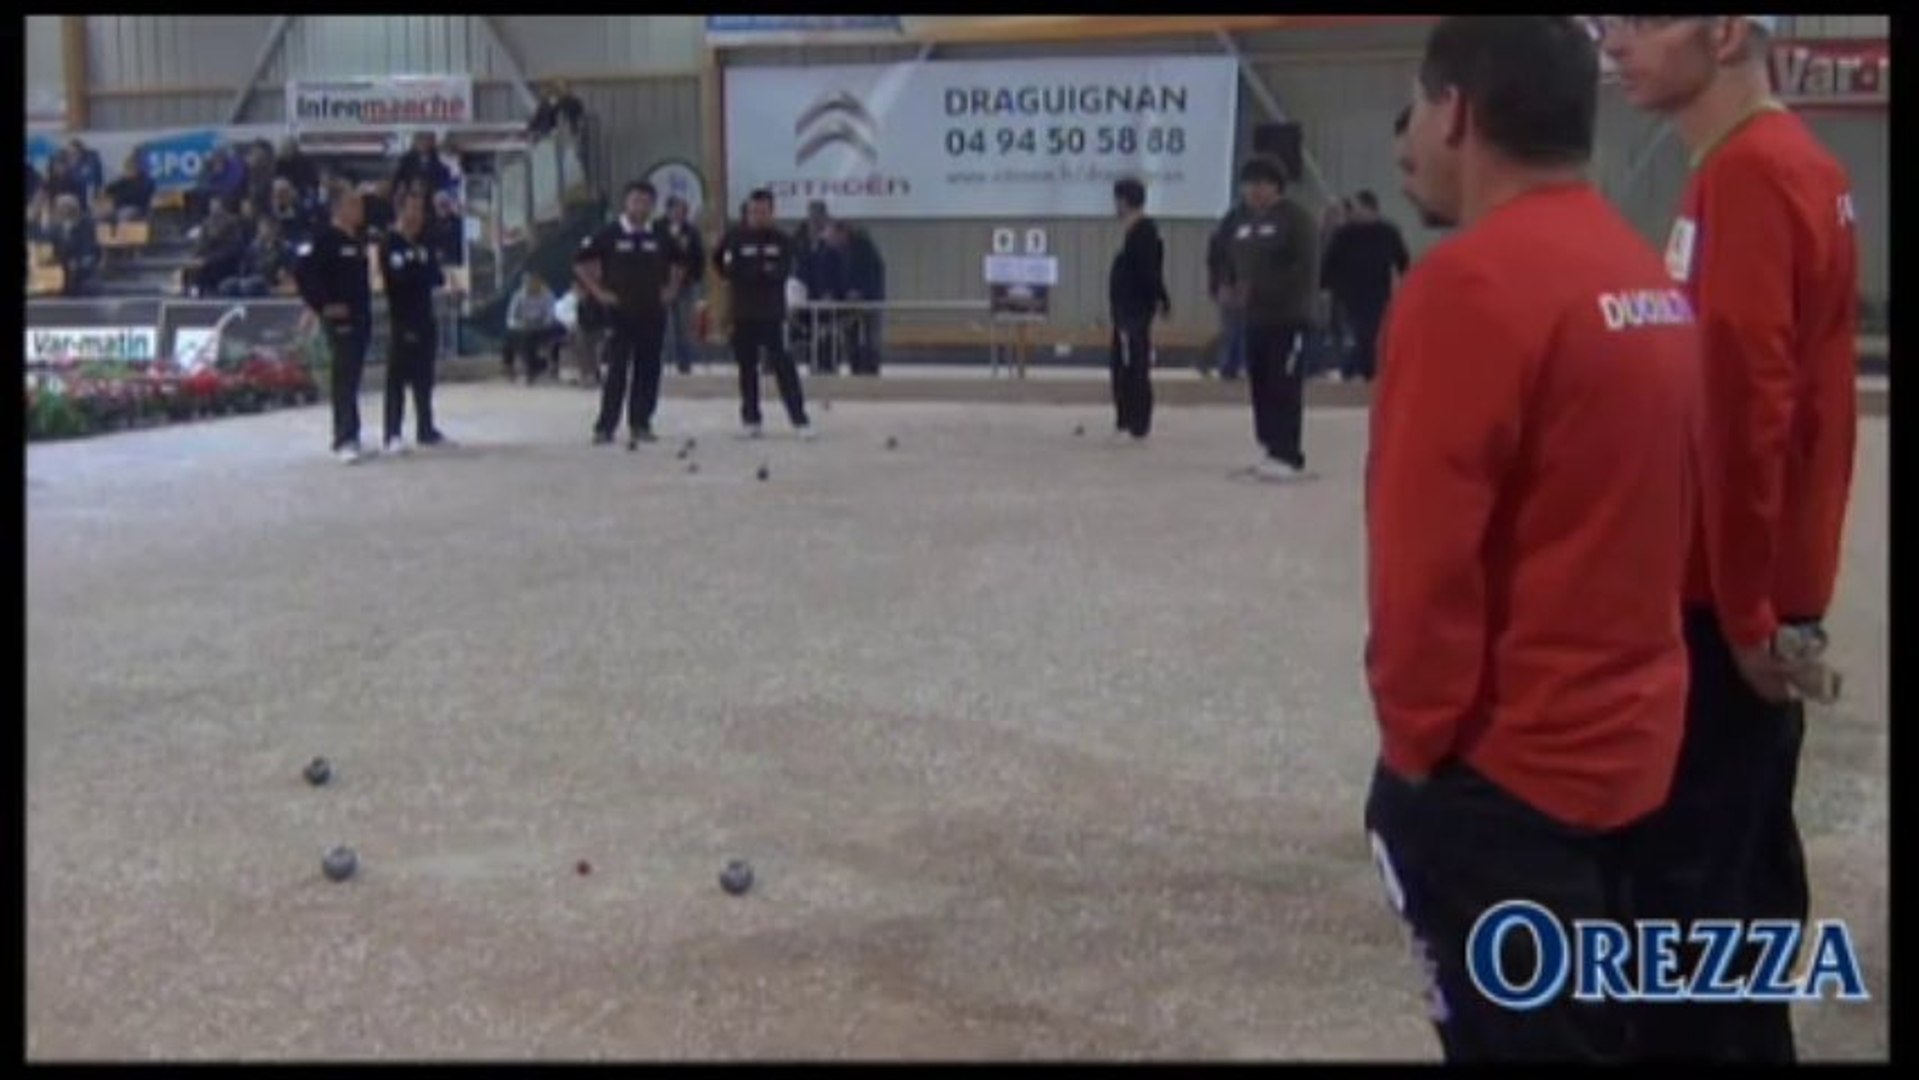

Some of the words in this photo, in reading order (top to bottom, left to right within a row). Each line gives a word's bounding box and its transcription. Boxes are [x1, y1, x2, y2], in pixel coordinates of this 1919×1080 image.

[944, 84, 1187, 116] DRAGUIGNAN
[946, 128, 986, 156] 04
[996, 128, 1036, 154] 94
[1047, 127, 1085, 154] 50
[1098, 127, 1137, 154] 58
[1147, 126, 1186, 154] 88
